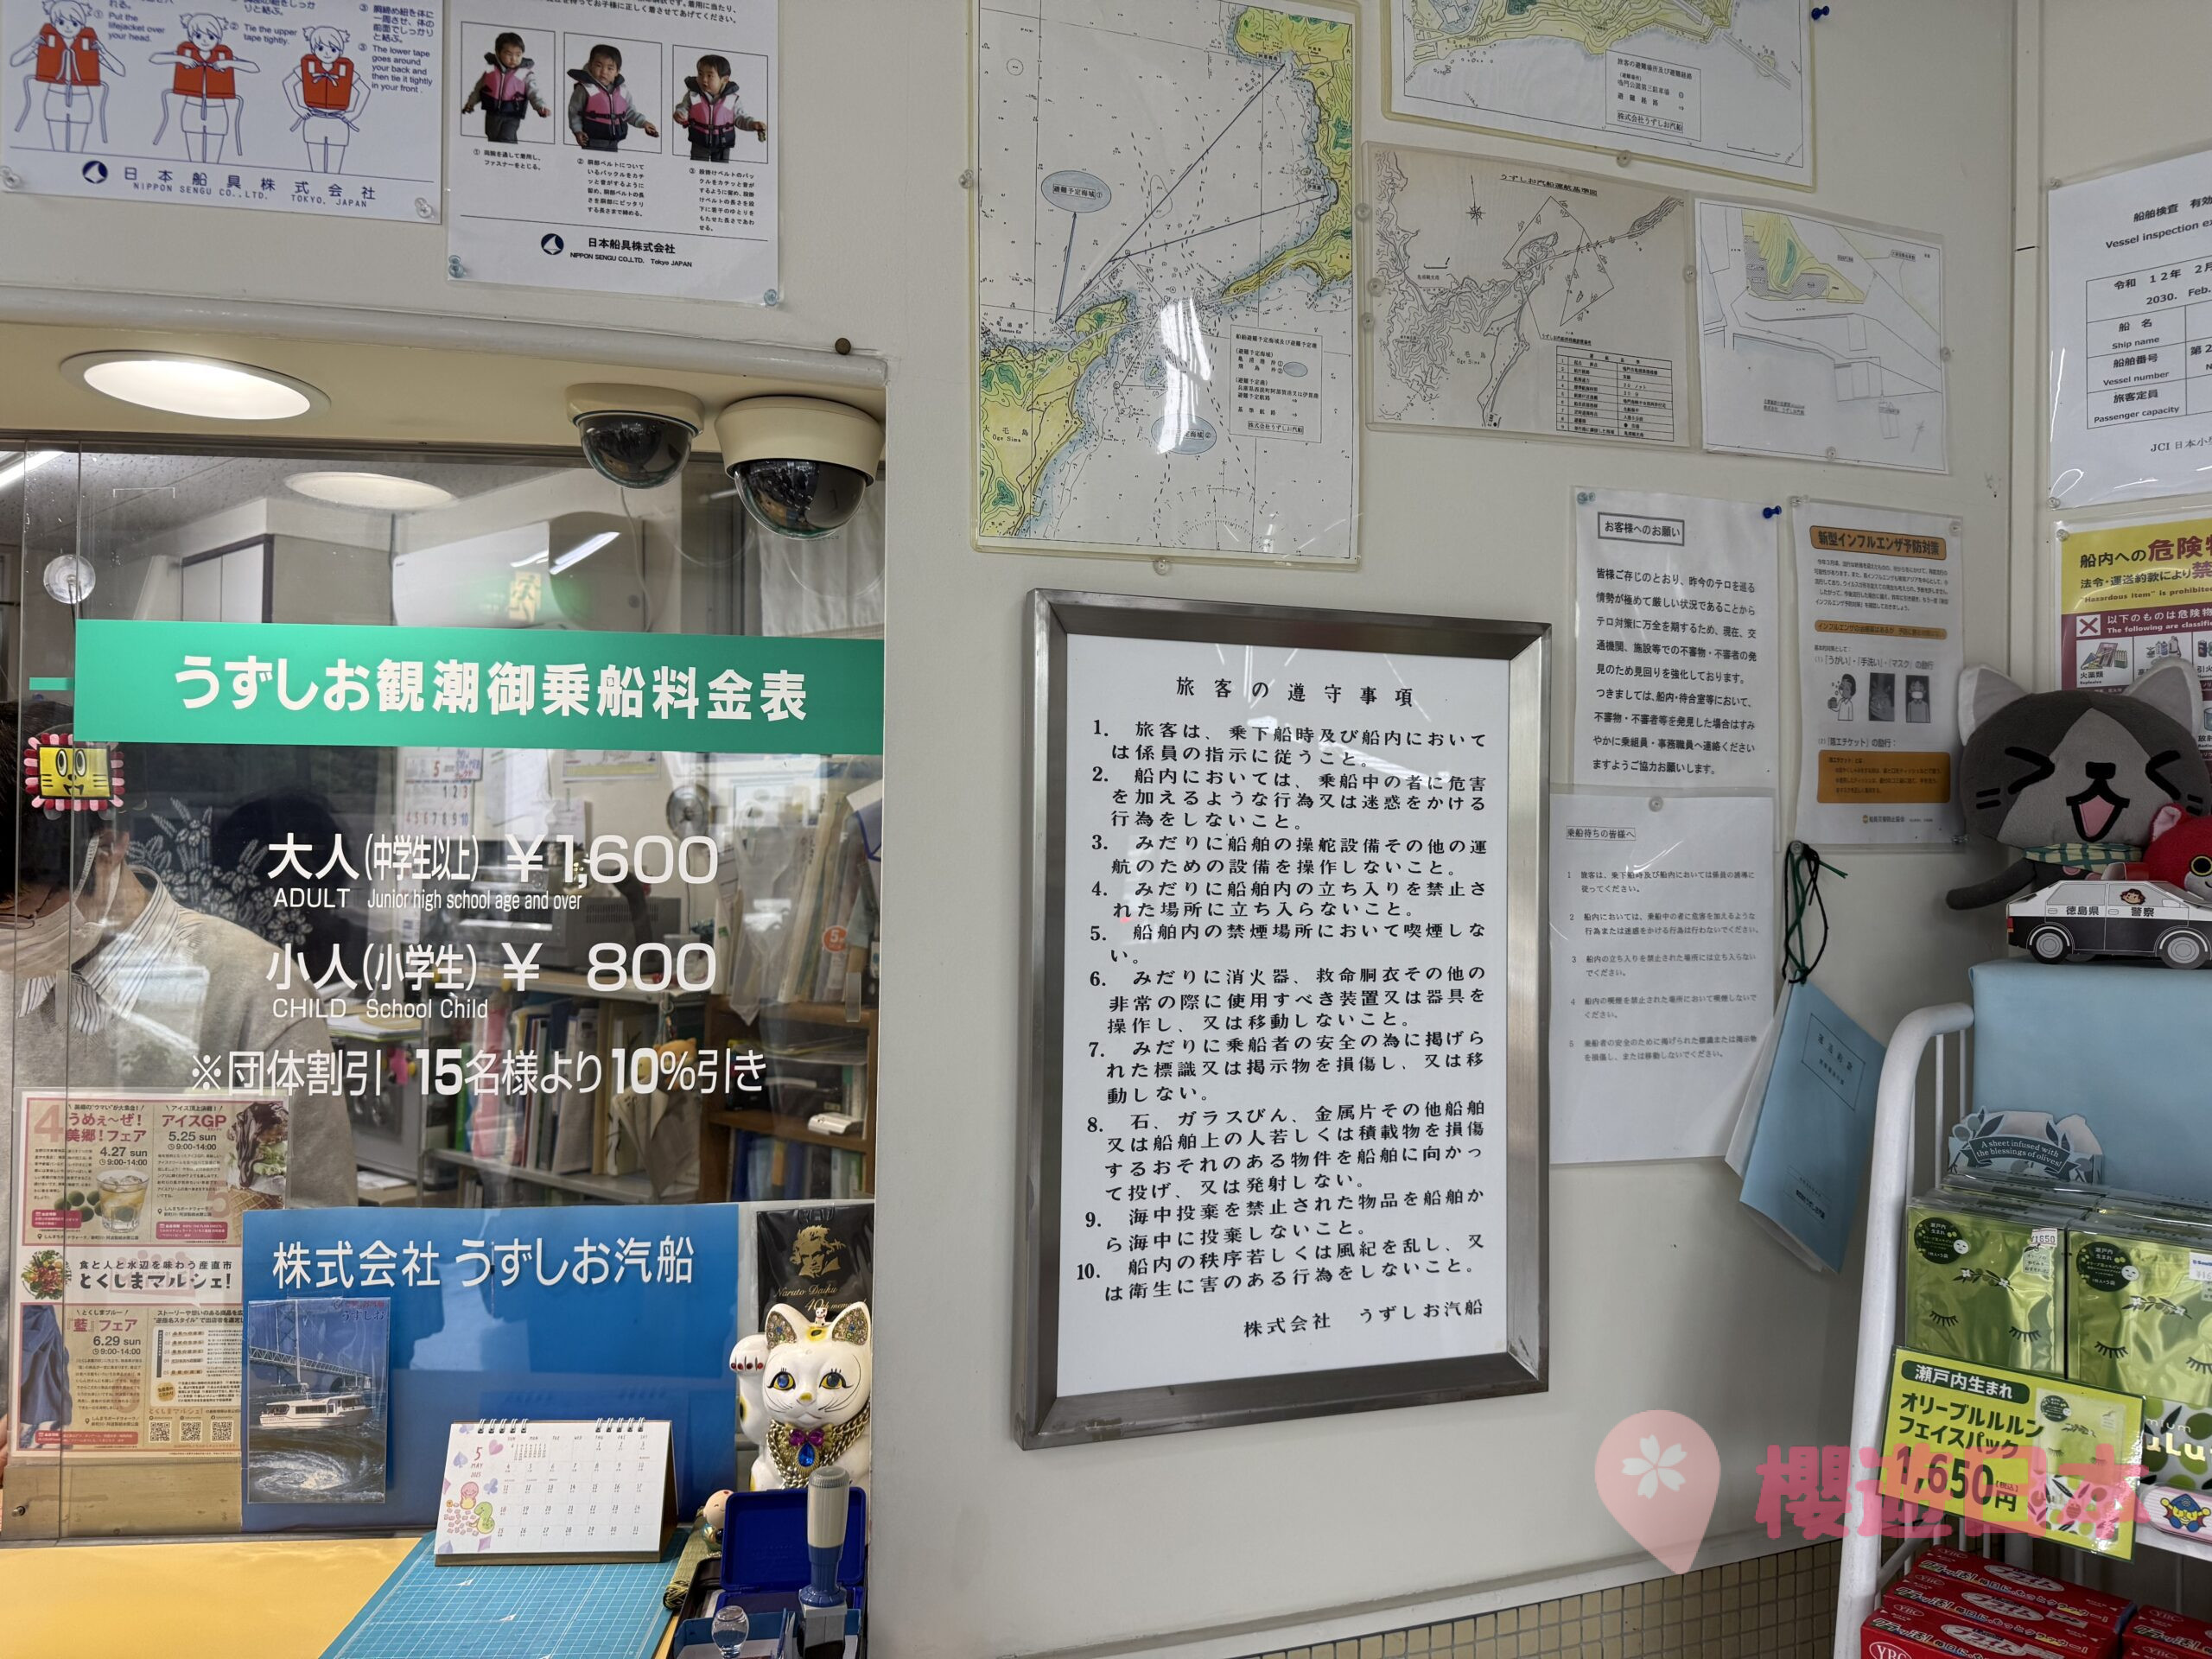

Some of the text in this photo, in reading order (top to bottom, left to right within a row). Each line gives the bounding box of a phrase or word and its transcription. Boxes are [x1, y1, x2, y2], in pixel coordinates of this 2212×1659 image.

[108, 22, 145, 33] lifejacket
[245, 24, 297, 37] Tie the upper
[372, 44, 387, 53] The
[413, 49, 430, 58] tape
[393, 57, 421, 66] around
[124, 167, 376, 200] 日本船具株式会社
[133, 182, 173, 193] NIPPON
[180, 187, 212, 196] SENGU
[335, 199, 367, 208] JAPAN
[2131, 203, 2178, 222] 船舶検査
[2106, 233, 2139, 249] Vessel
[2142, 222, 2199, 242] inspection
[588, 238, 676, 254] 日本船具株式会社
[2114, 278, 2137, 290] 令和
[2145, 285, 2211, 305] 2030. Feb.
[2112, 336, 2160, 350] Ship name
[2113, 353, 2158, 369] 船舶番号
[2103, 371, 2170, 386] Vessel number
[2113, 390, 2158, 404] 旅客定員
[2094, 406, 2179, 424] Passenger capacity
[1605, 521, 1680, 537] お客様へのお願い
[1818, 531, 1939, 555] 新型インフルエンザ予防対策
[1597, 568, 1755, 594] 皆様ご存じのとおり、昨今のテロを巡る
[1596, 591, 1755, 616] 情勢が極めて厳しい状況であることから
[1597, 616, 1756, 639] テロ対策に万全を期するため、現在、交
[1597, 639, 1757, 662] 通機関、施設等での不審物・不審者の発
[1597, 664, 1745, 684] 見のため見回りを強化しております。
[174, 654, 806, 722] うずしお観潮御乗船料金表
[1176, 676, 1414, 708] 旅客の遵守事項
[1597, 688, 1751, 708] つきましては、船内・待合室等において、
[1594, 712, 1755, 731] 不審物・不審者等を発見した場合はすみ
[1093, 720, 1487, 748] 1. 旅客は、乗下船時及び船内において
[1593, 735, 1755, 753] やかに乗組員・事務職員へ連絡ください
[1112, 744, 1370, 768] は係員の指示に従うこと。
[1593, 759, 1715, 775] ますようご協力お願いします。
[1092, 766, 1487, 793] 2. 船内においては、乗船中の者に危害
[1112, 789, 1486, 811] を加えるような行為又は迷惑をかける
[1111, 810, 1302, 830] 行為をしないこと。
[1567, 827, 1635, 839] 乗船待ちの皆様へ
[1092, 835, 1488, 855] 3. みだりに船舶の操舵設備その他の運
[507, 834, 718, 888] ¥1,600
[1111, 858, 1457, 877] 航のための設備を操作しないこと。
[1091, 880, 1487, 898] 4. みだりに船舶内の立ち入りを禁止さ
[274, 888, 582, 912] ADULT Junior high school age and over
[1113, 901, 1415, 918] れた場所に立ち入らないこと。
[2066, 906, 2154, 918] 徳島県 警察
[1090, 923, 1486, 942] 5. 船舶内の禁煙場所において喫煙しな
[587, 943, 716, 991] 800
[1111, 950, 1140, 965] い。
[1090, 966, 1486, 988] 6. みだりに消火器、救命胴衣その他の
[273, 998, 488, 1019] CHILD School Child
[1109, 988, 1484, 1013] 非常の際に使用すべき装置又は器具を
[1108, 1012, 1409, 1034] 操作し、又は移動しないこと。
[1090, 1030, 1485, 1058] 7. みだりに乗船者の安全の為に掲げら
[1106, 1052, 1484, 1079] れた標識又は掲示物を損傷し、又は移
[1108, 1086, 1211, 1105] 動しない。
[34, 1104, 64, 1143] 4
[162, 1115, 226, 1128] アイスGP
[1087, 1100, 1485, 1133] 8. 石、ガラスびん、金属片その他船舶
[168, 1131, 196, 1141] 5.25
[1108, 1122, 1484, 1153] 又は船舶上の人若しくは積載物を損傷
[100, 1147, 127, 1157] 4.27
[1976, 1149, 1990, 1158] the
[1990, 1147, 2026, 1157] blessings
[2036, 1154, 2063, 1167] olives!
[2011, 1140, 2040, 1151] infused
[2041, 1147, 2059, 1158] with
[1105, 1145, 1482, 1178] するおそれのある物件を船舶に向かっ
[1106, 1172, 1366, 1202] て投げ、又は発射しない。
[1085, 1188, 1484, 1228] 9. 海中投棄を禁止された物品を船舶か
[1106, 1219, 1366, 1253] ら海中に投棄しないこと。
[79, 1260, 232, 1270] 食と人と水辺を味わう産直市
[273, 1236, 694, 1289] 株式会社 うずしお汽船
[1077, 1234, 1484, 1281] 10. 船内の秩序若しくは風紀を乱し、又
[79, 1273, 232, 1289] とくしまマルシェ!
[1106, 1258, 1473, 1302] は衛生に害のある行為をしないこと。
[774, 1286, 805, 1297] Naruto
[342, 1310, 386, 1320] うずしお
[1244, 1299, 1484, 1338] 株式会社 うずしお汽船
[93, 1336, 120, 1346] 6.29
[1915, 1363, 2013, 1400] 瀬戸内生まれ
[1901, 1391, 2044, 1439] オリーブルルルン
[1898, 1416, 2019, 1459] フェイスパック
[474, 1446, 483, 1461] 5
